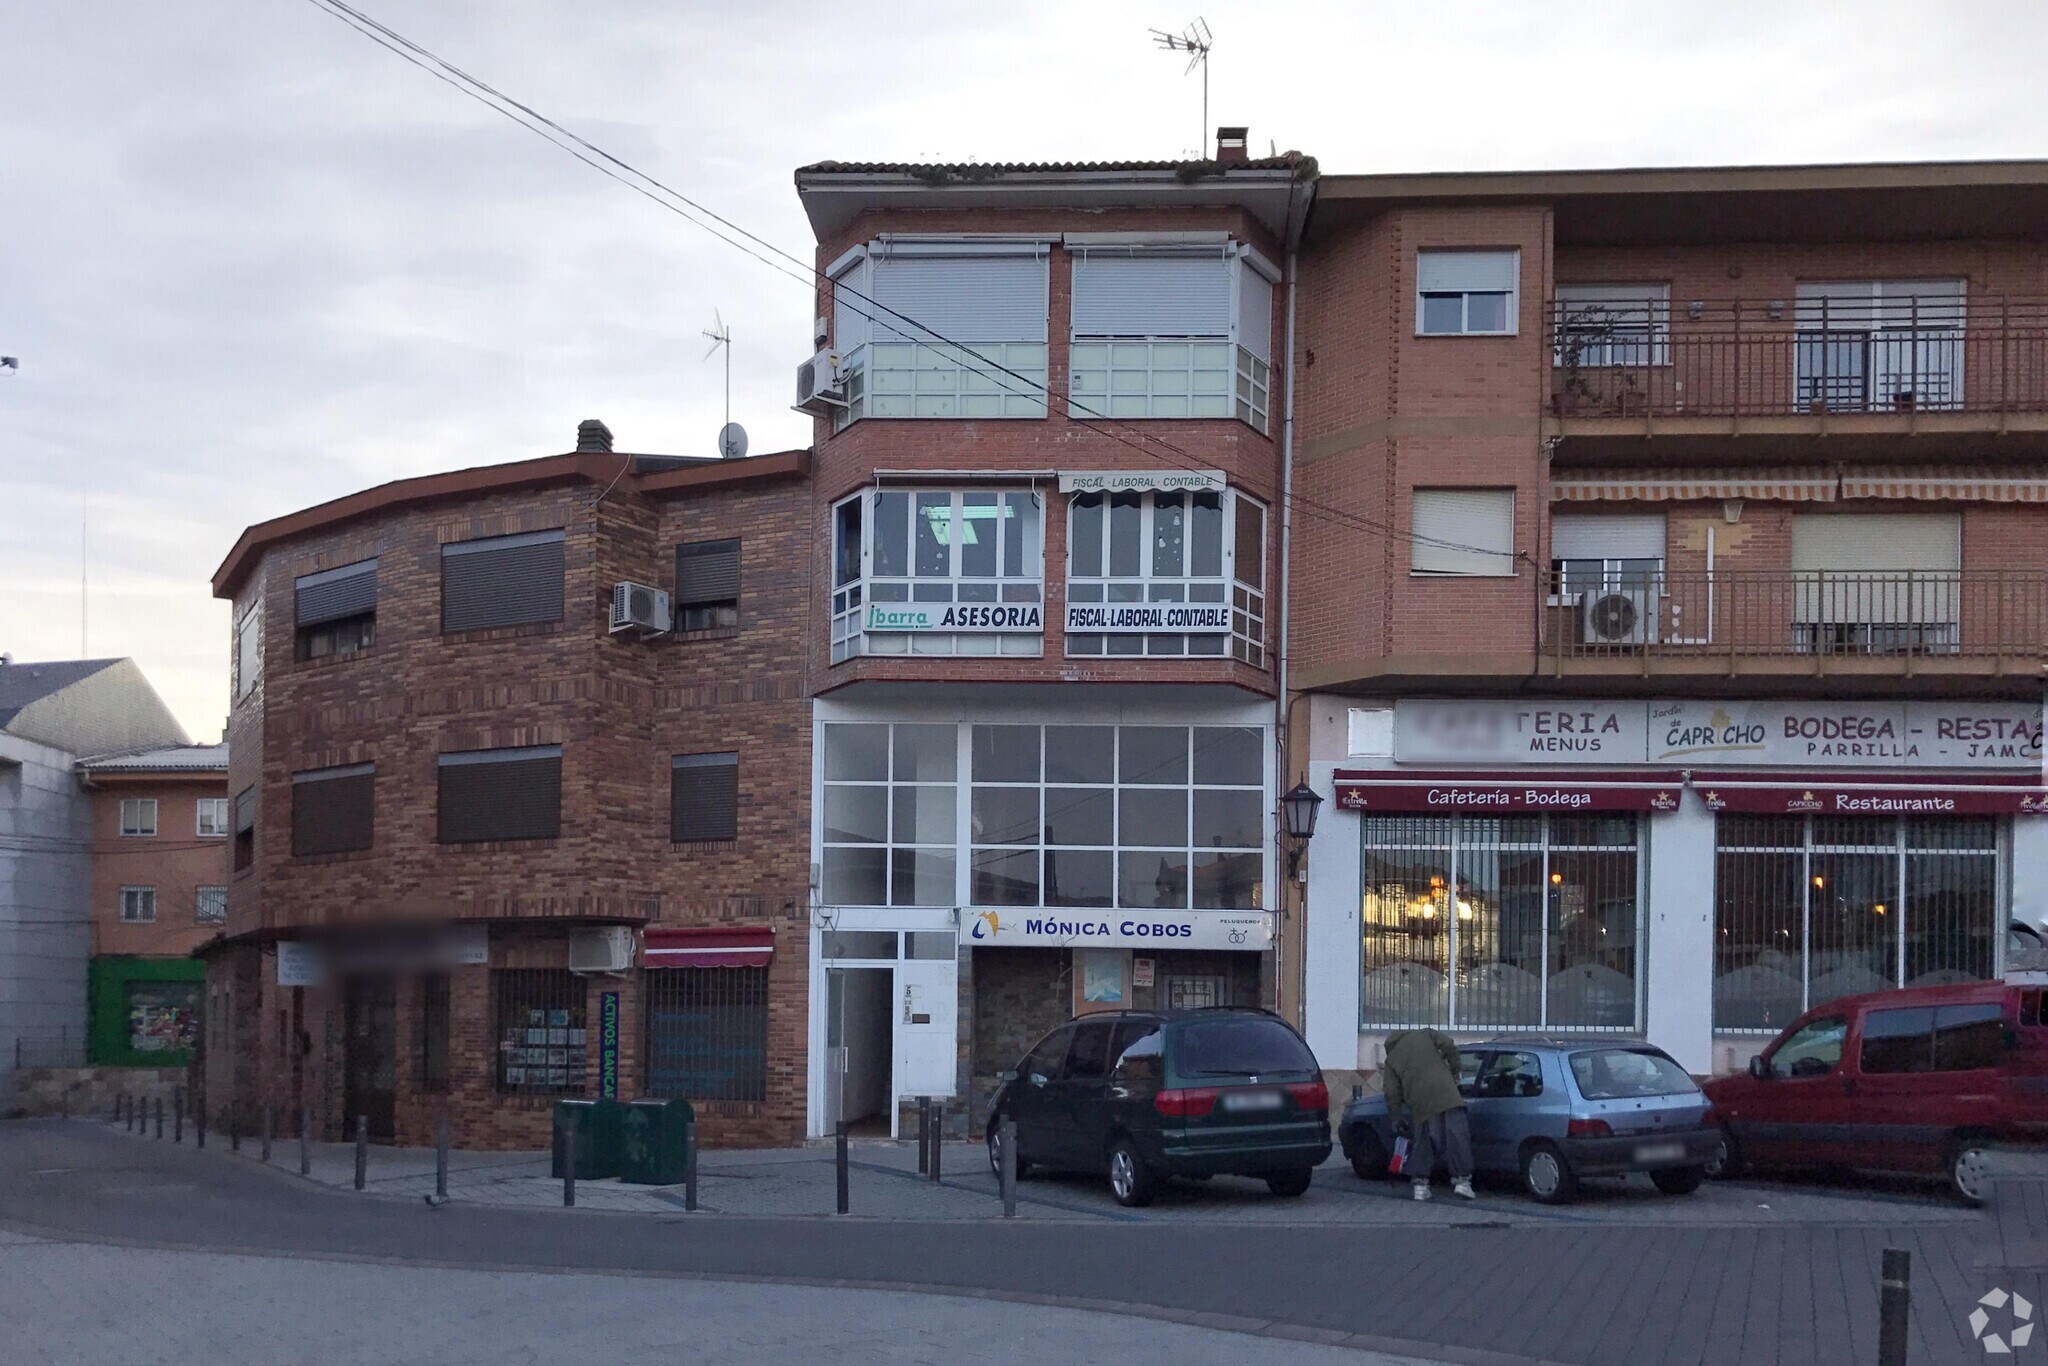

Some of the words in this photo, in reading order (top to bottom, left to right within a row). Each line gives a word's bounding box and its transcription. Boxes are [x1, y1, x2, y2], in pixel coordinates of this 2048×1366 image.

[1072, 477, 1104, 488] FISCAL
[1112, 477, 1156, 488] LABORAL
[1163, 476, 1213, 487] CONTABLE
[940, 607, 1041, 627] ASESORIA
[1670, 719, 1682, 728] de
[1784, 716, 1895, 739] BODEGA
[1530, 737, 1602, 752] MENUS
[1808, 743, 1920, 757] PARRILLA
[1427, 788, 1510, 806] Cafetería
[1525, 790, 1592, 808] Bodega
[1836, 794, 1955, 811] Restaurante
[1025, 916, 1111, 936] MÓNICA
[1120, 921, 1193, 938] COBOS
[604, 994, 616, 1046] ACTIVOS
